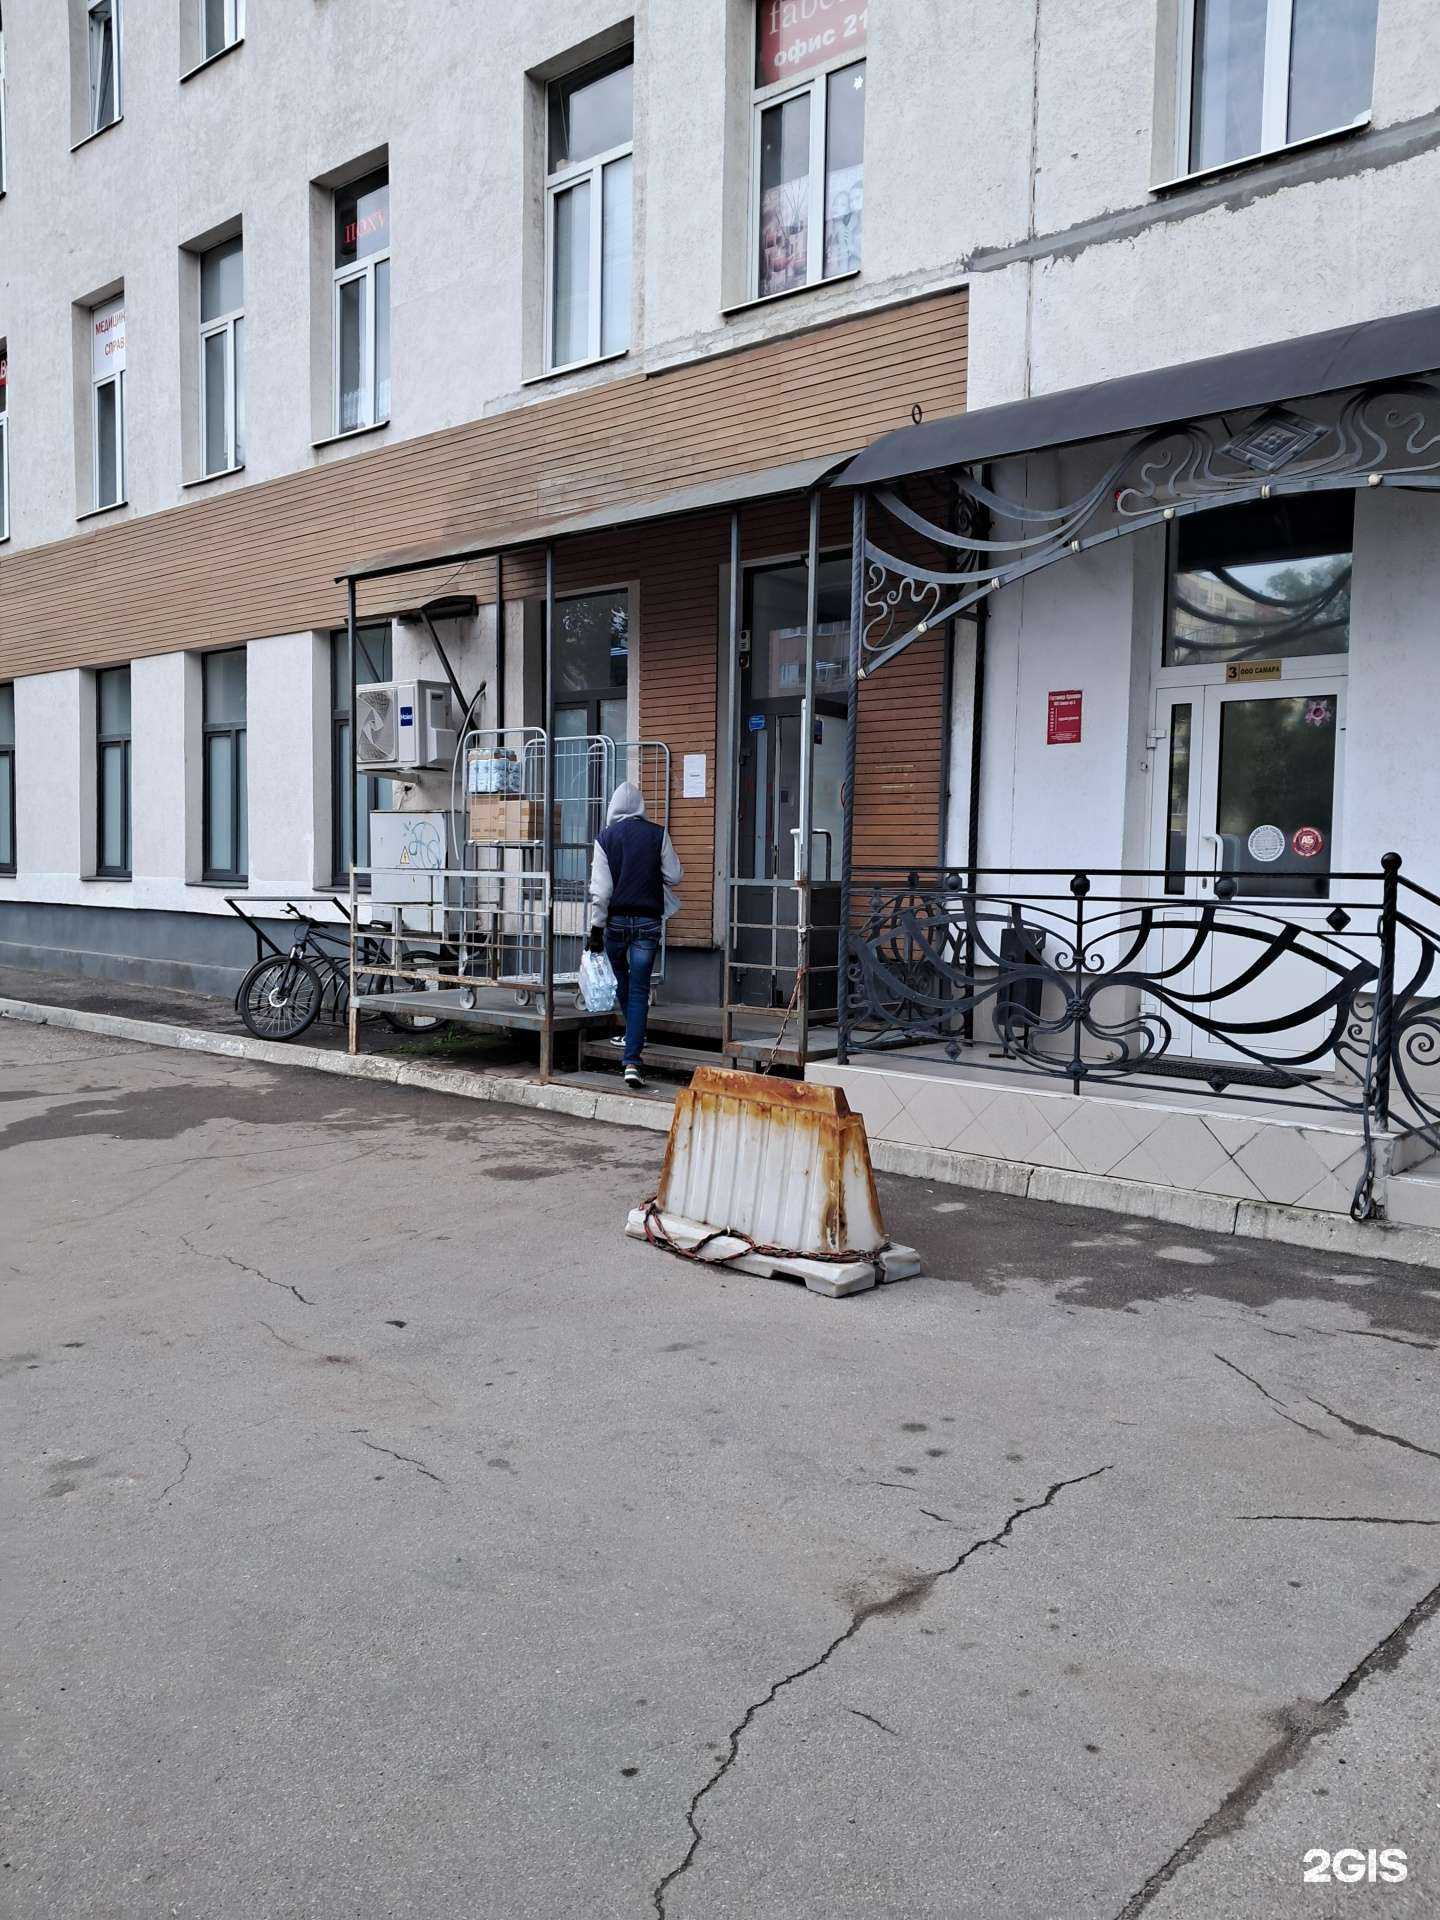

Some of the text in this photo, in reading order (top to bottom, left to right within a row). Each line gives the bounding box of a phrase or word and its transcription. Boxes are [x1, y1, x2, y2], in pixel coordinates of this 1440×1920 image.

[774, 28, 836, 67] офис
[1228, 666, 1237, 679] 3
[1255, 665, 1280, 674] САМАРА
